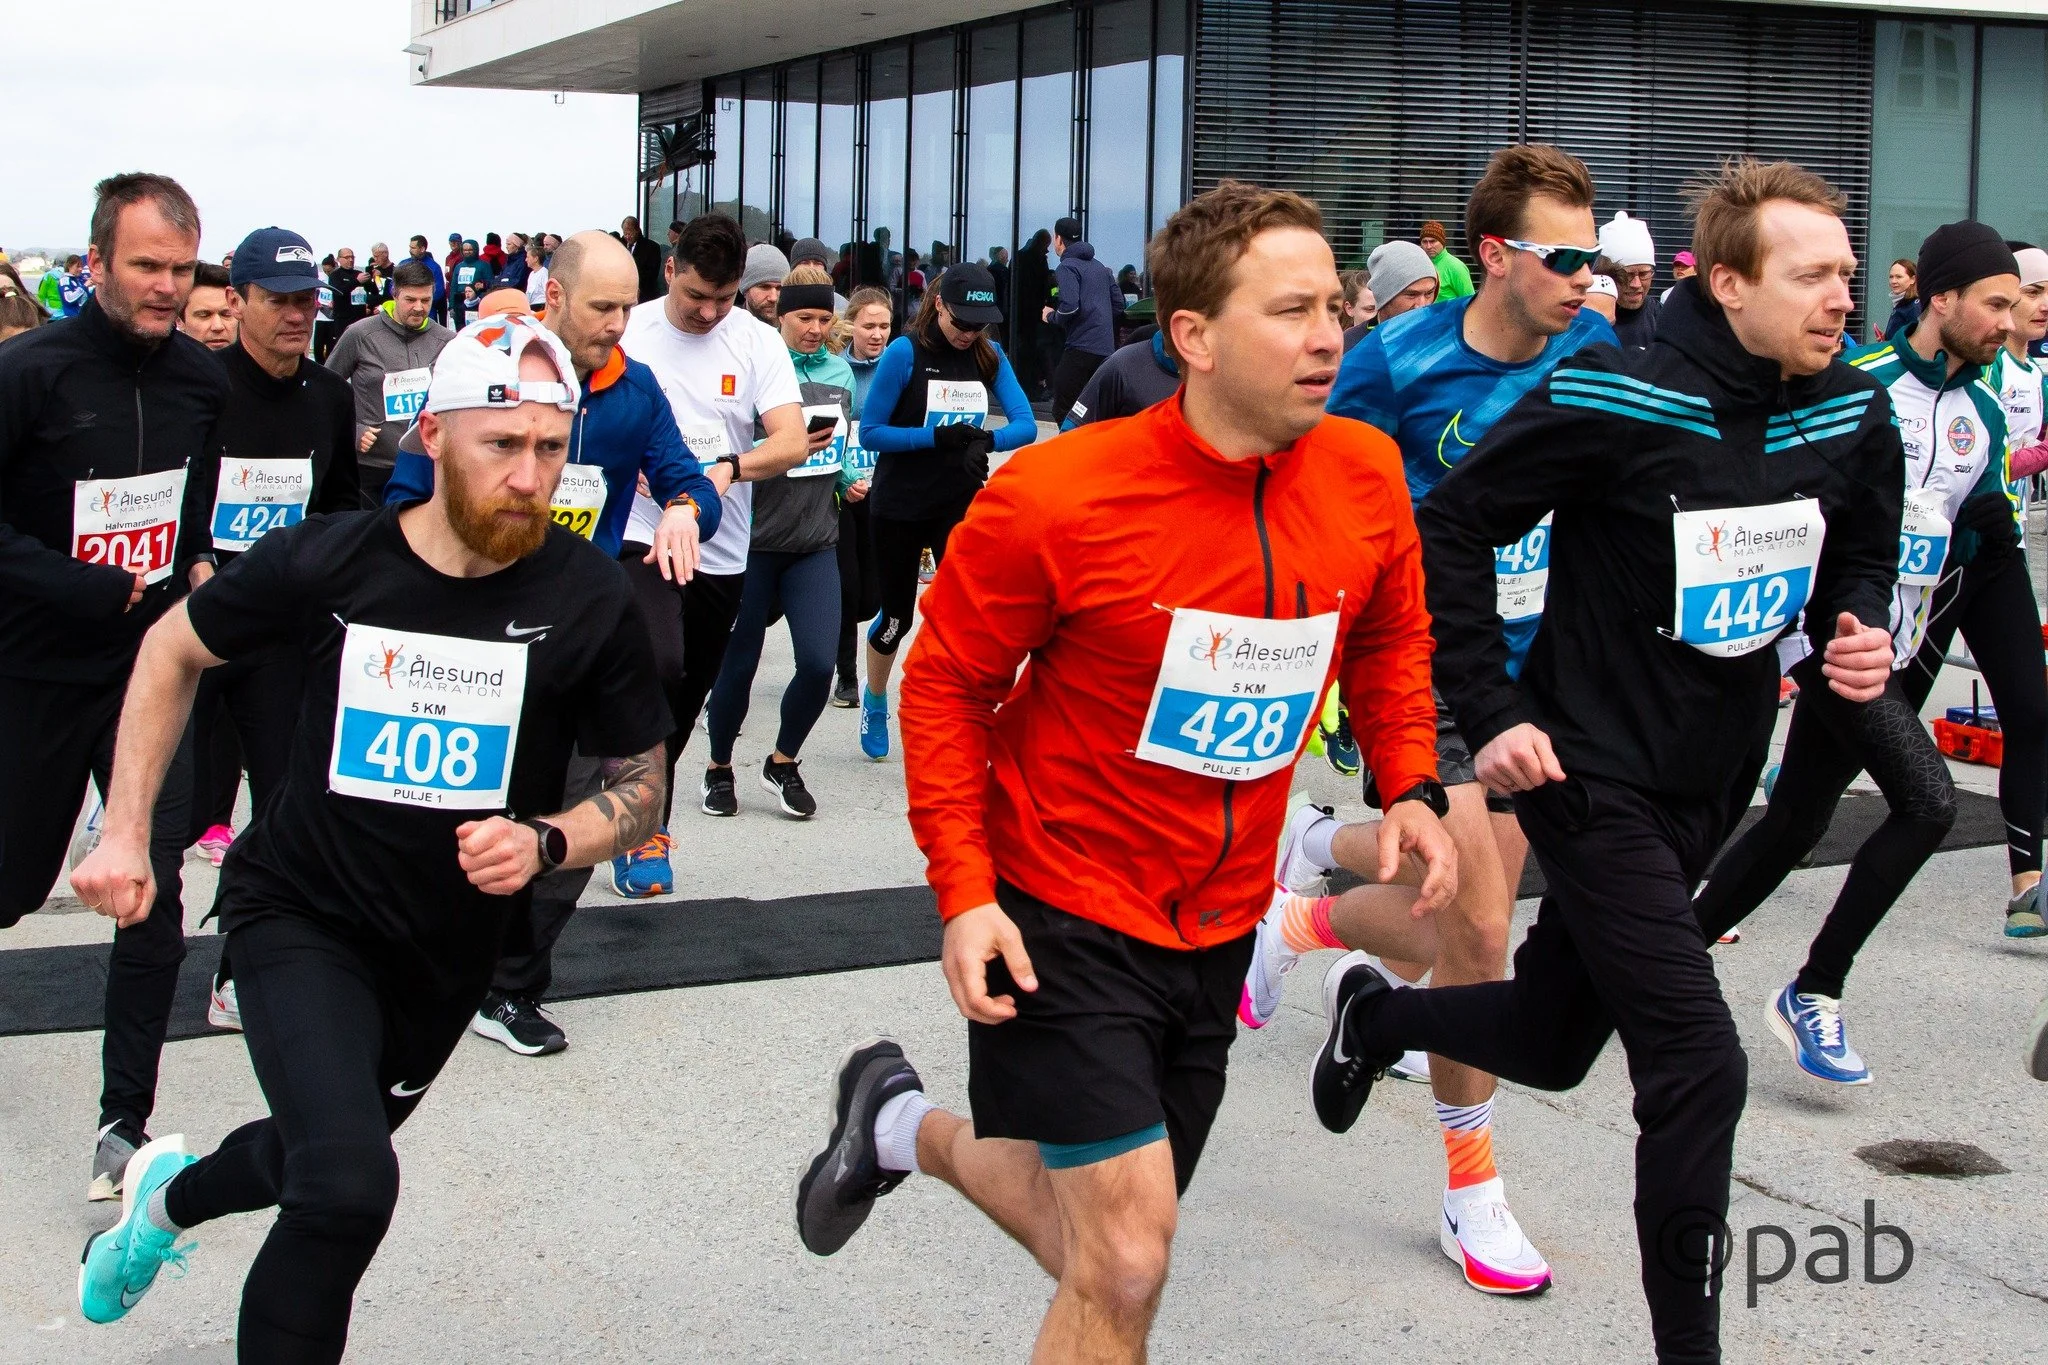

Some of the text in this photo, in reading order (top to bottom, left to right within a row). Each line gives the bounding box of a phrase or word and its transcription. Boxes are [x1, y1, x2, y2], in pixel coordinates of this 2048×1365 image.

[966, 291, 994, 302] HOKA
[952, 389, 982, 398] Ålesund
[255, 469, 302, 484] Ålesund
[562, 476, 599, 488] esund
[120, 486, 173, 507] Ålesund
[120, 498, 172, 515] MARATON
[105, 517, 158, 531] Halvmaraton
[229, 506, 288, 539] 424
[1903, 524, 1917, 532] KM
[1733, 523, 1809, 548] Ålesund
[83, 526, 168, 571] 2041
[1494, 528, 1547, 571] 49
[1733, 539, 1807, 558] MARATON
[1898, 535, 1932, 573] 03
[1737, 564, 1764, 578] 5 KM
[1497, 577, 1517, 585] ULJE
[1703, 576, 1789, 639] 442
[1235, 637, 1319, 662] Ålesund
[1726, 638, 1763, 653] PULJE 1
[409, 654, 504, 687] Ålesund
[1231, 659, 1315, 673] MARATON
[408, 679, 502, 698] MARATON
[1231, 683, 1267, 695] 5 KM
[411, 702, 447, 716] 5 KM
[1179, 700, 1291, 758] 428
[365, 720, 480, 788] 408
[1202, 762, 1251, 776] PULJE 1
[393, 788, 443, 804] PULJE 1
